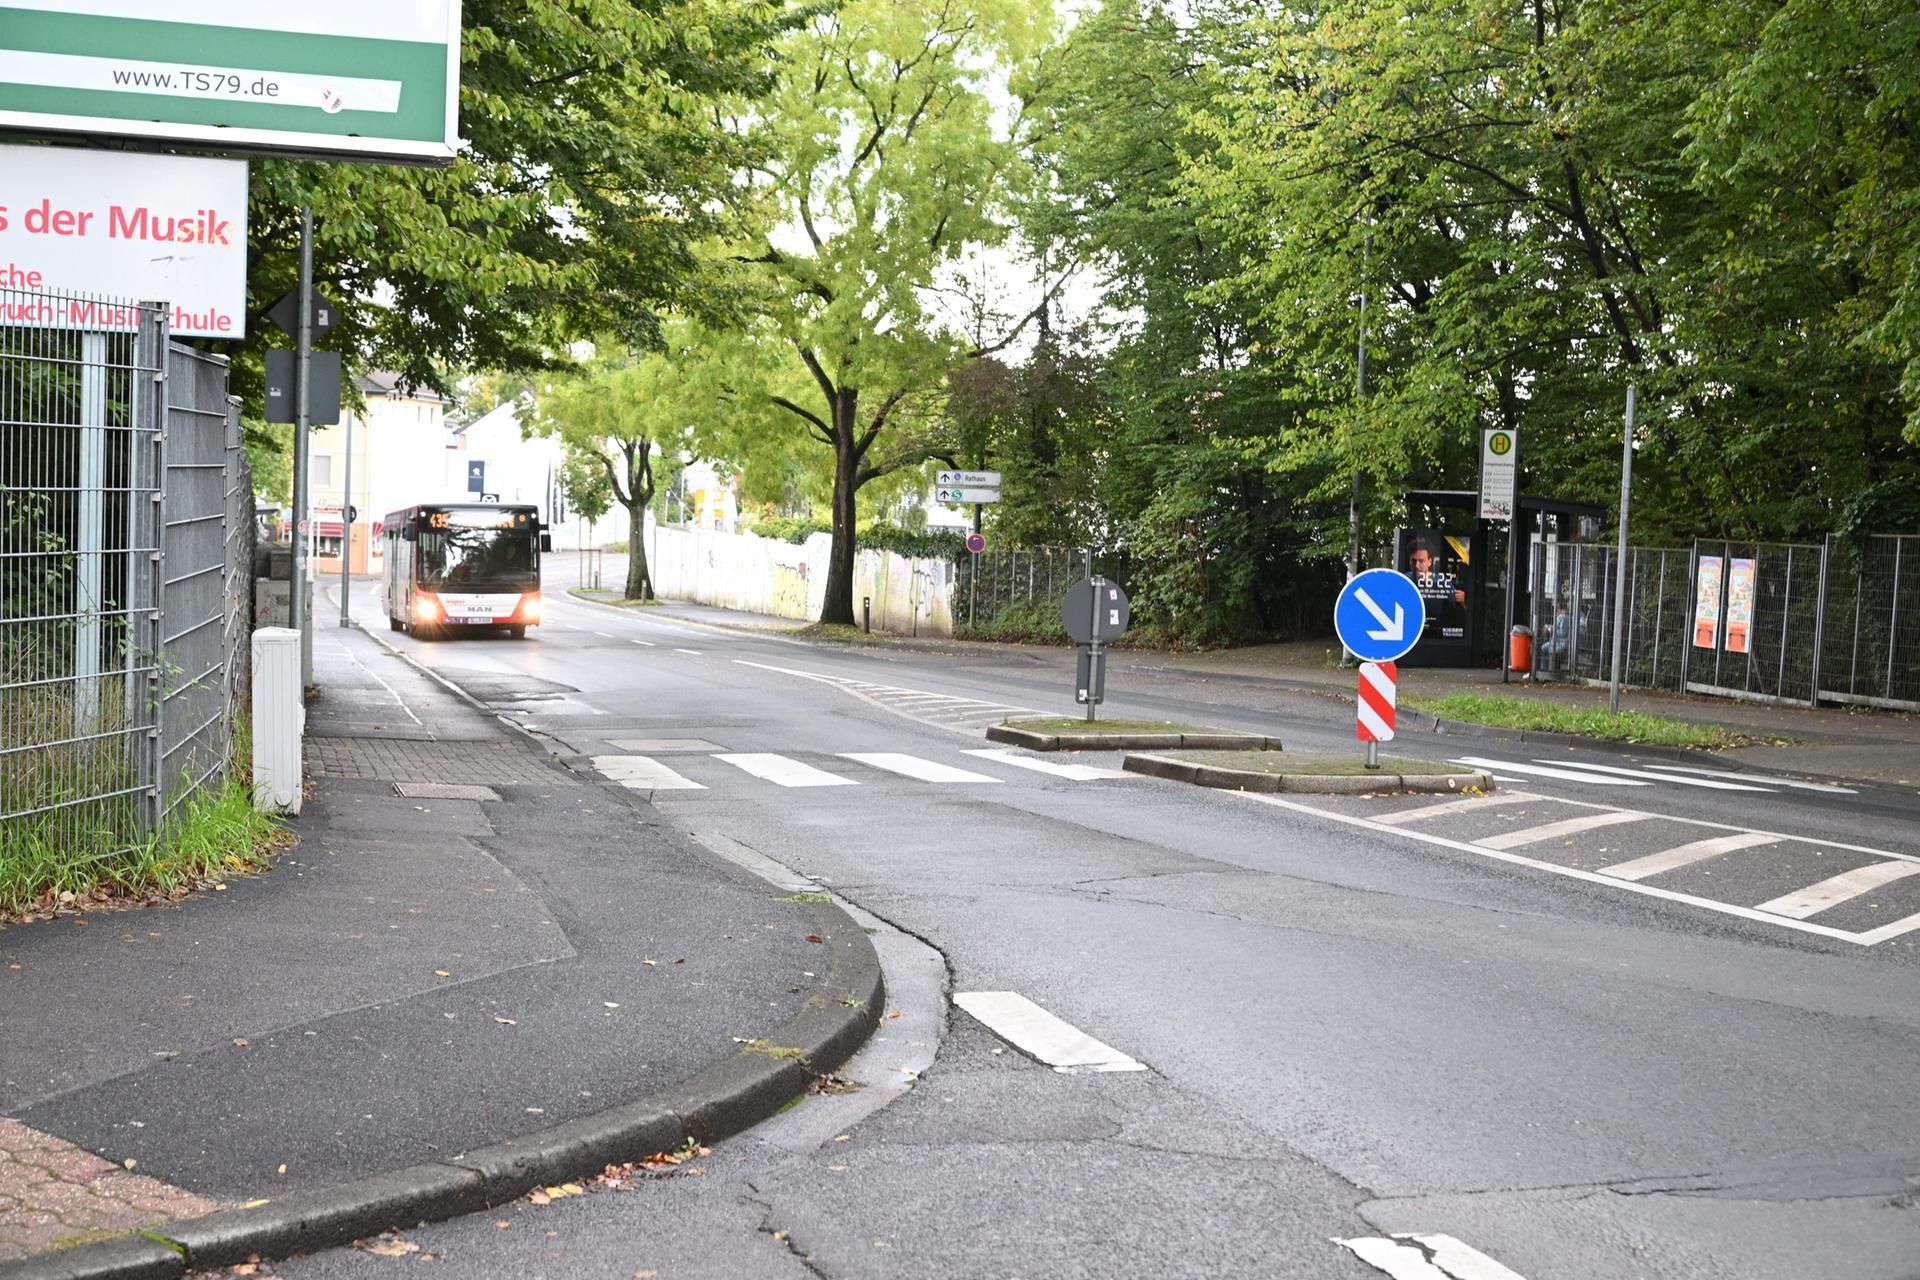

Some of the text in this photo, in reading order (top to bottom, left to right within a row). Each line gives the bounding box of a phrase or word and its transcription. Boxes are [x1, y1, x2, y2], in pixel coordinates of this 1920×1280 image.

[112, 70, 280, 98] www.TS79.de
[24, 198, 94, 237] der
[108, 204, 231, 246] Musik
[1495, 437, 1505, 451] H
[964, 474, 986, 482] Rathaus
[430, 512, 449, 529] 435
